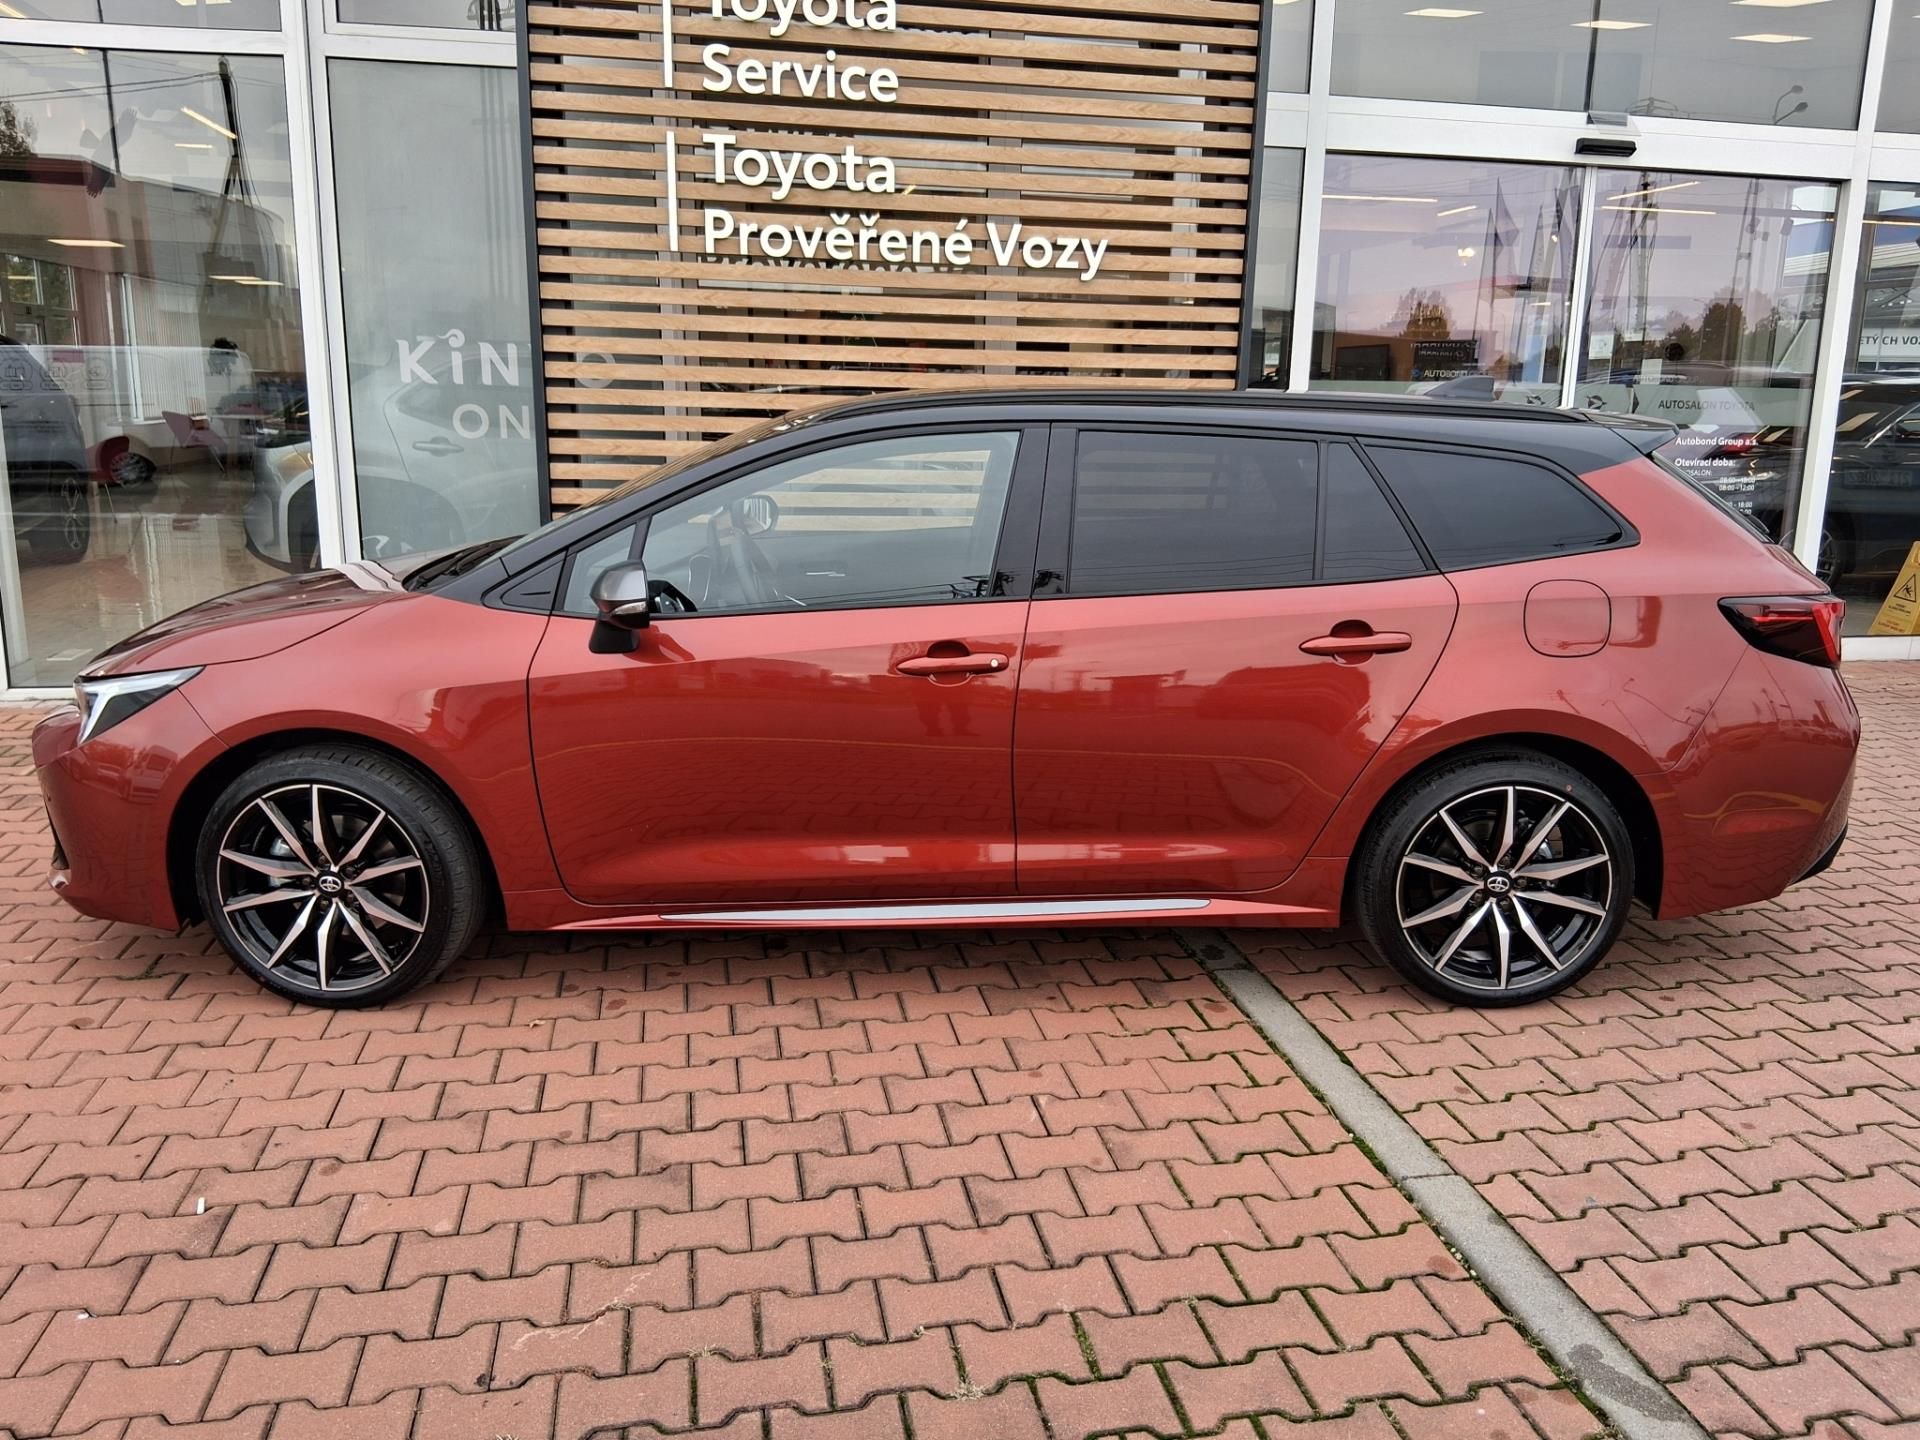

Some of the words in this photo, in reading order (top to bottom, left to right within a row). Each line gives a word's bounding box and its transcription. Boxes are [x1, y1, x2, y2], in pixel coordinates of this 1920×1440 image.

[702, 43, 899, 103] Service
[702, 133, 897, 201] Toyota
[703, 207, 973, 266] Prověřené
[986, 221, 1109, 281] Vozy
[1658, 400, 1716, 410] AUTOSALON
[1675, 437, 1717, 446] Autobond
[1718, 437, 1744, 448] Group
[1712, 458, 1737, 467] doba:
